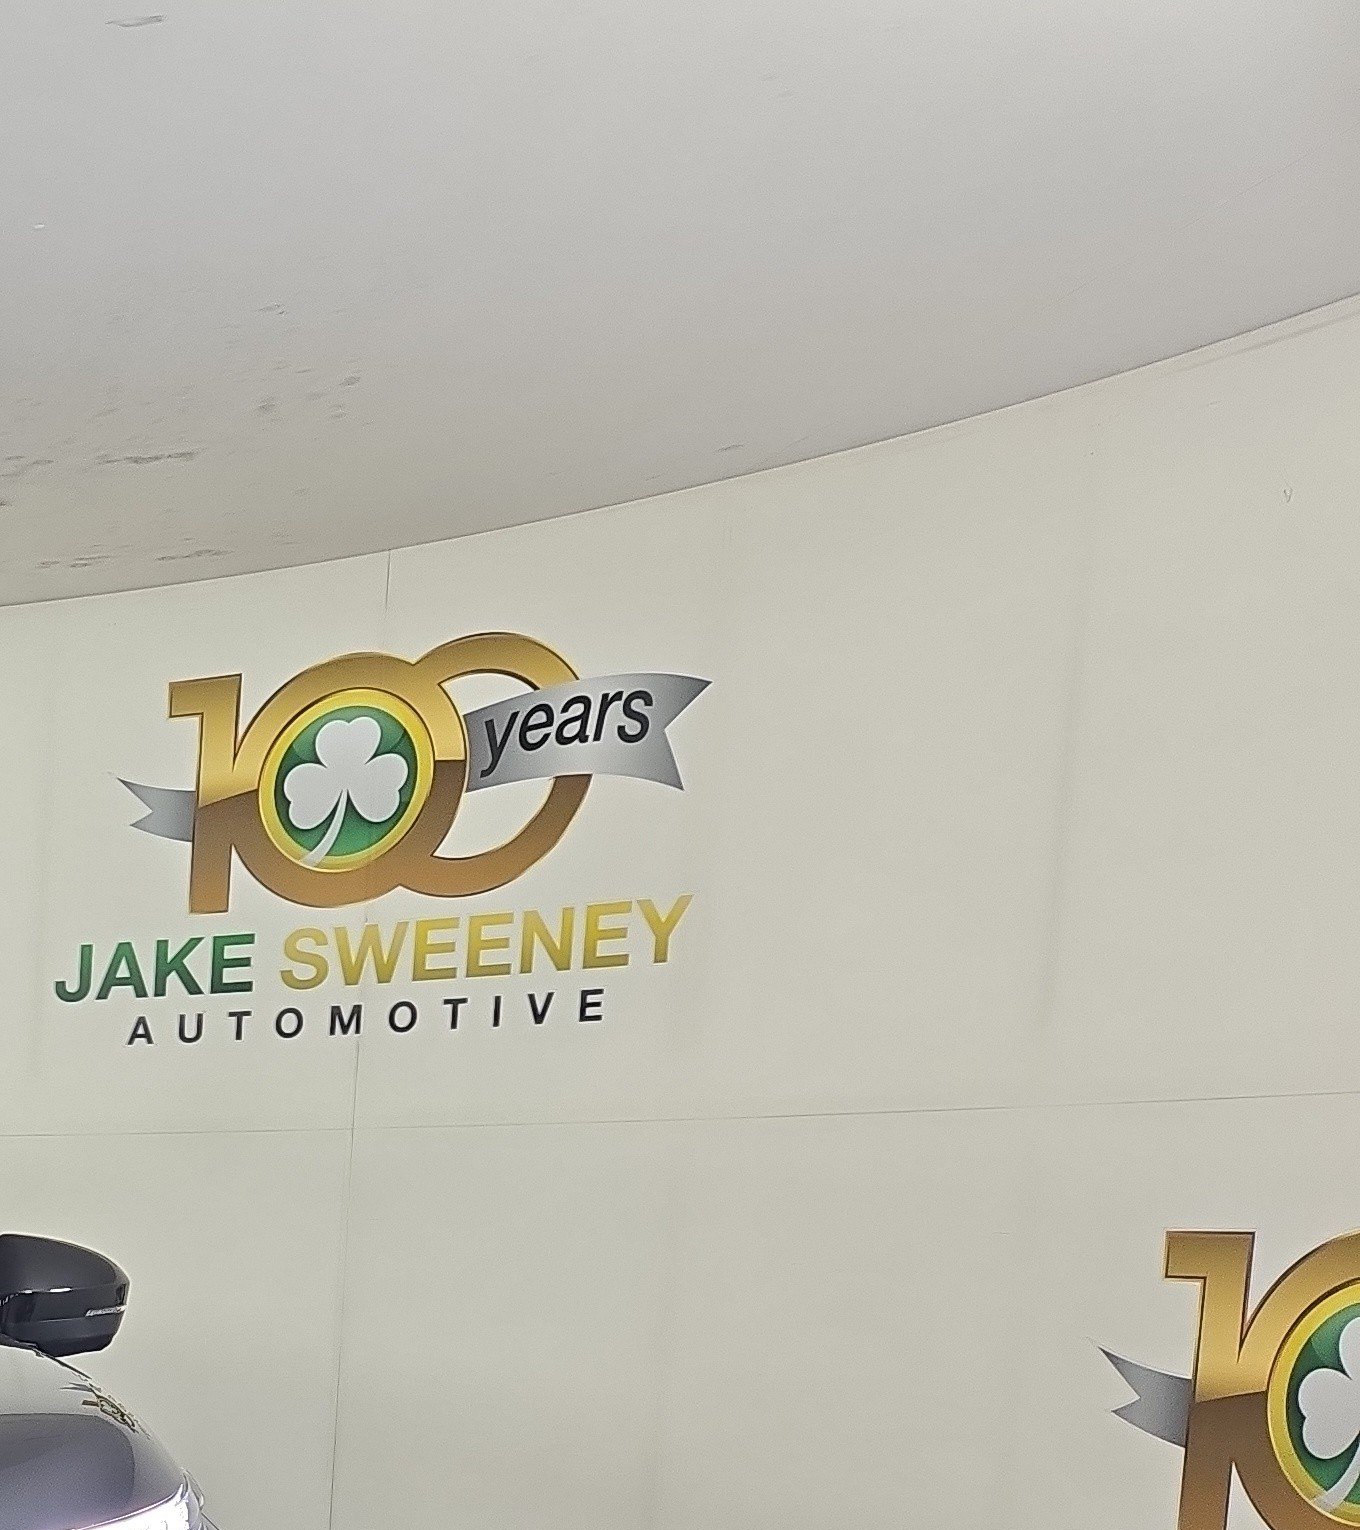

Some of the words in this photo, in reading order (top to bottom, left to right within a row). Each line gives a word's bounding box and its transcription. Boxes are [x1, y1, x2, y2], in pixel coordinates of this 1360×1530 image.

[168, 631, 593, 914] 100
[480, 687, 654, 777] years
[54, 933, 256, 1003] JAKE
[280, 894, 695, 990] SWEENEY
[127, 988, 606, 1046] AUTOMOTIVE
